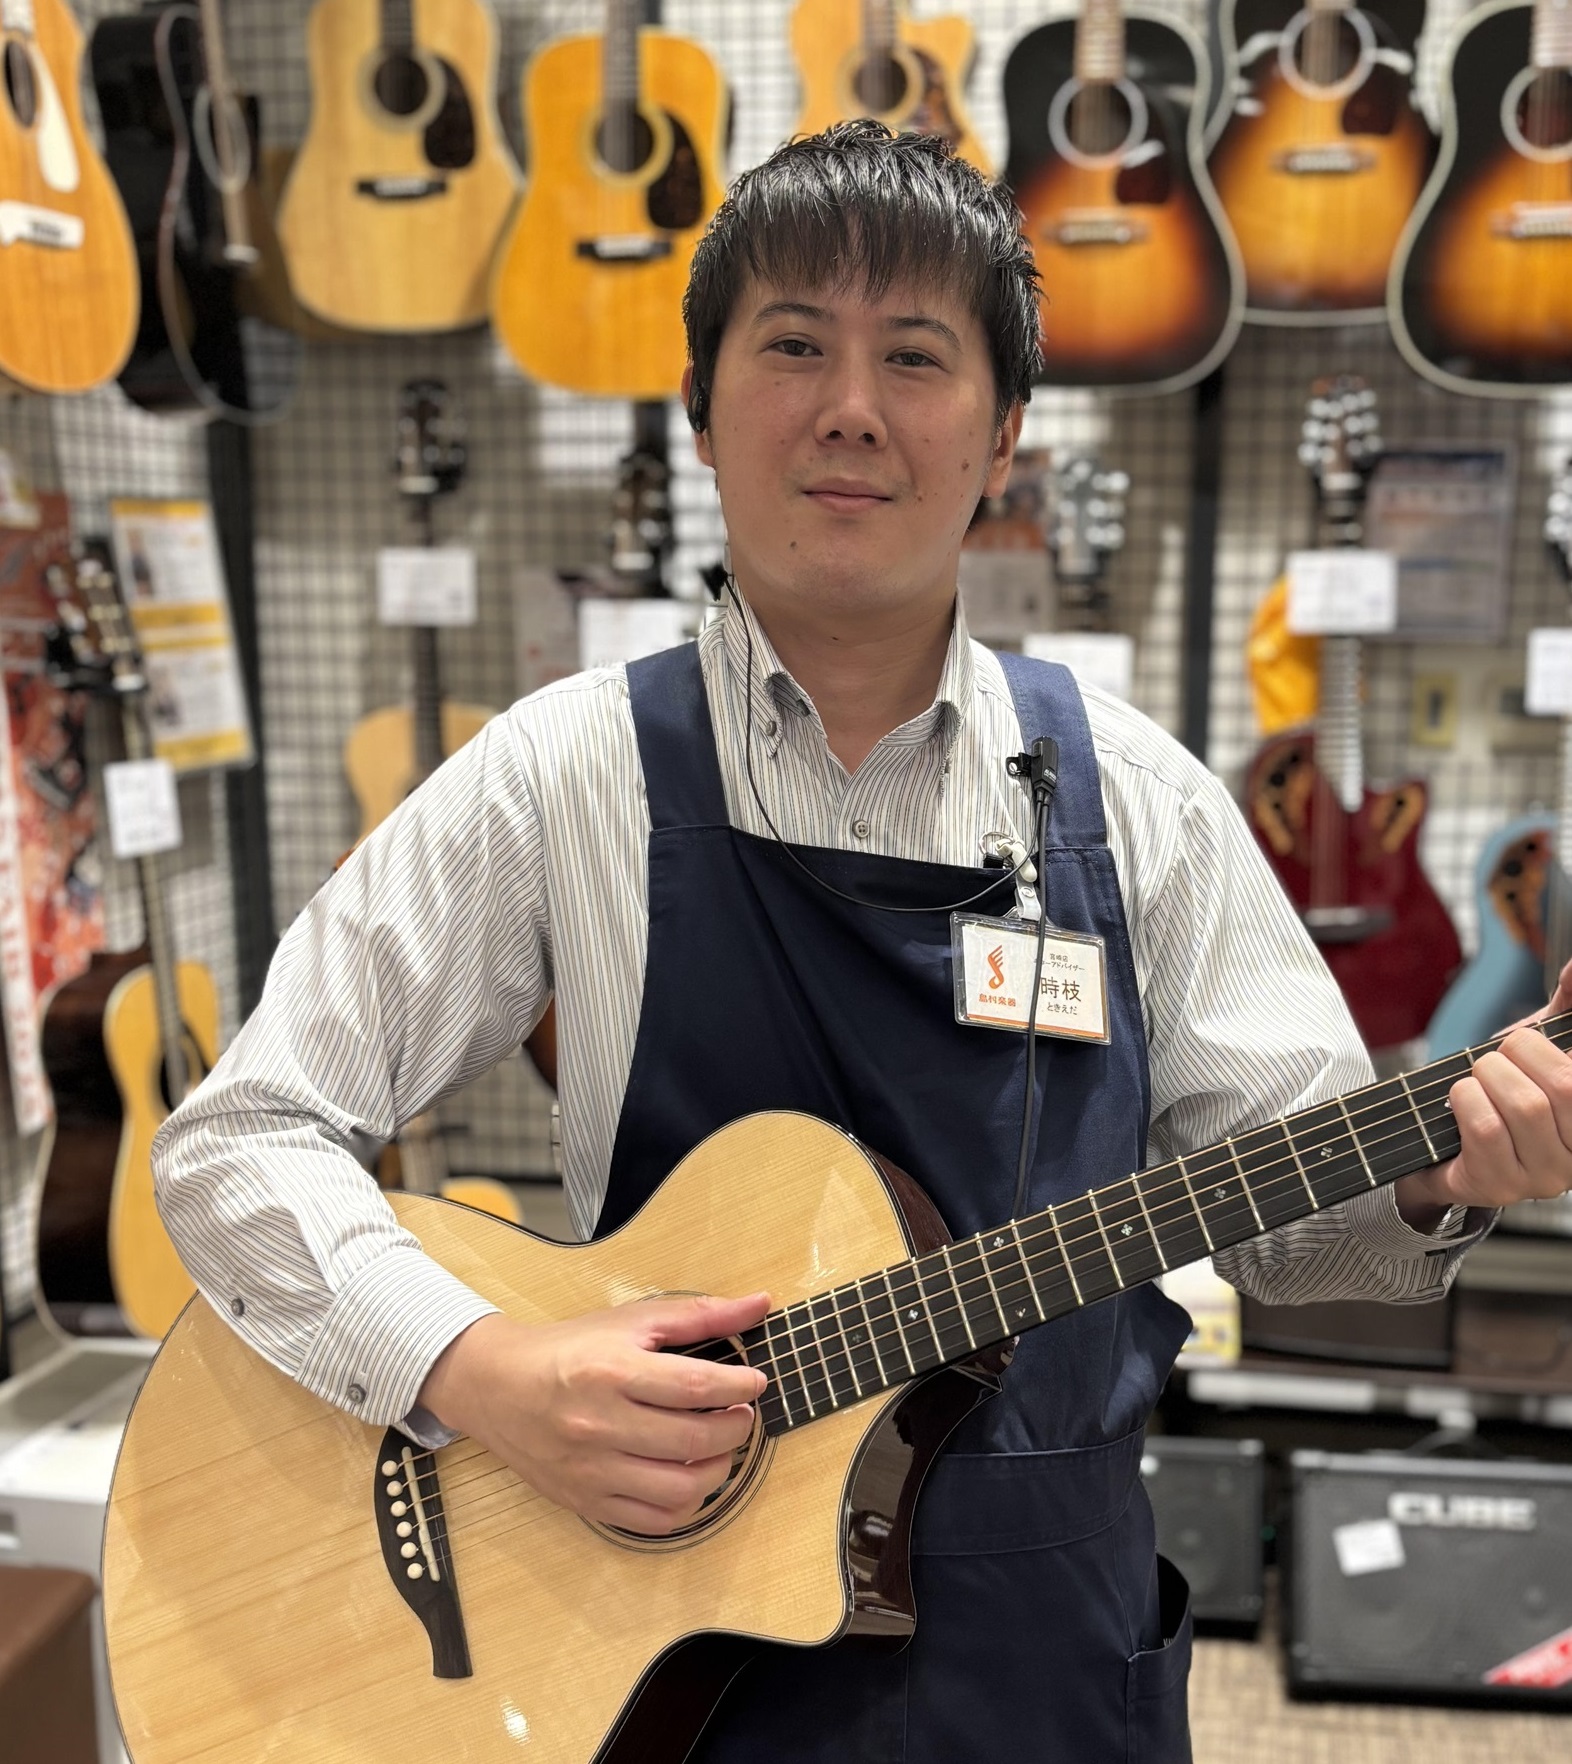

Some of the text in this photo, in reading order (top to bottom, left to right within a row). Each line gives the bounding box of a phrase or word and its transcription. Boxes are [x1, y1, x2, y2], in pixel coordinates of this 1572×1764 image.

[1040, 976, 1081, 1002] 時枝
[978, 993, 1016, 1007] 島村楽器
[1047, 1002, 1078, 1015] ときえだ
[1389, 1492, 1535, 1530] CUBE
